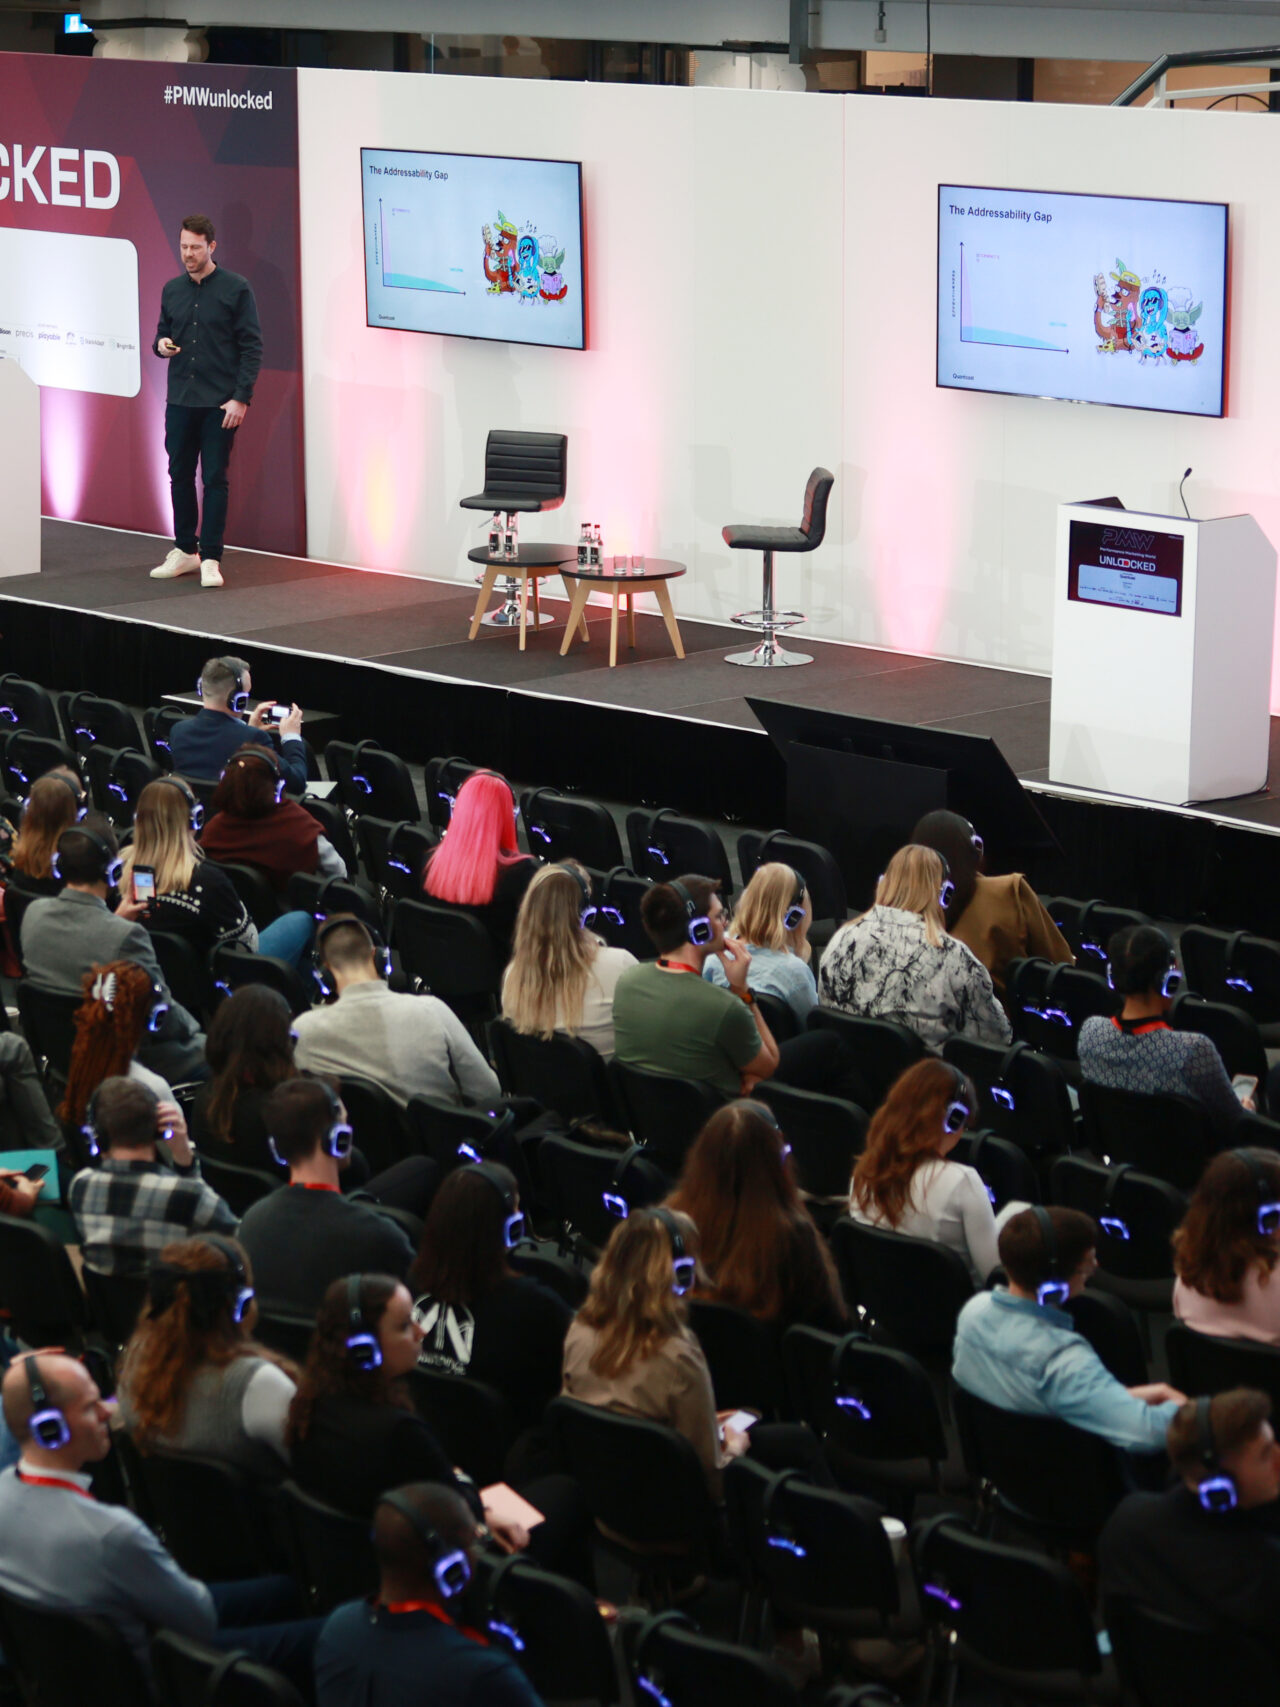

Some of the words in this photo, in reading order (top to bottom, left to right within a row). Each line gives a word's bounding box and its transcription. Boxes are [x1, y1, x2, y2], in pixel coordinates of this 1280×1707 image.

[164, 86, 273, 110] #PMWunlocked
[369, 165, 382, 175] The
[384, 167, 432, 181] Addressability
[434, 170, 449, 181] Gap
[949, 204, 965, 215] The
[967, 206, 1031, 223] Addressability
[1034, 211, 1053, 224] Gap
[1102, 528, 1154, 551] PMW
